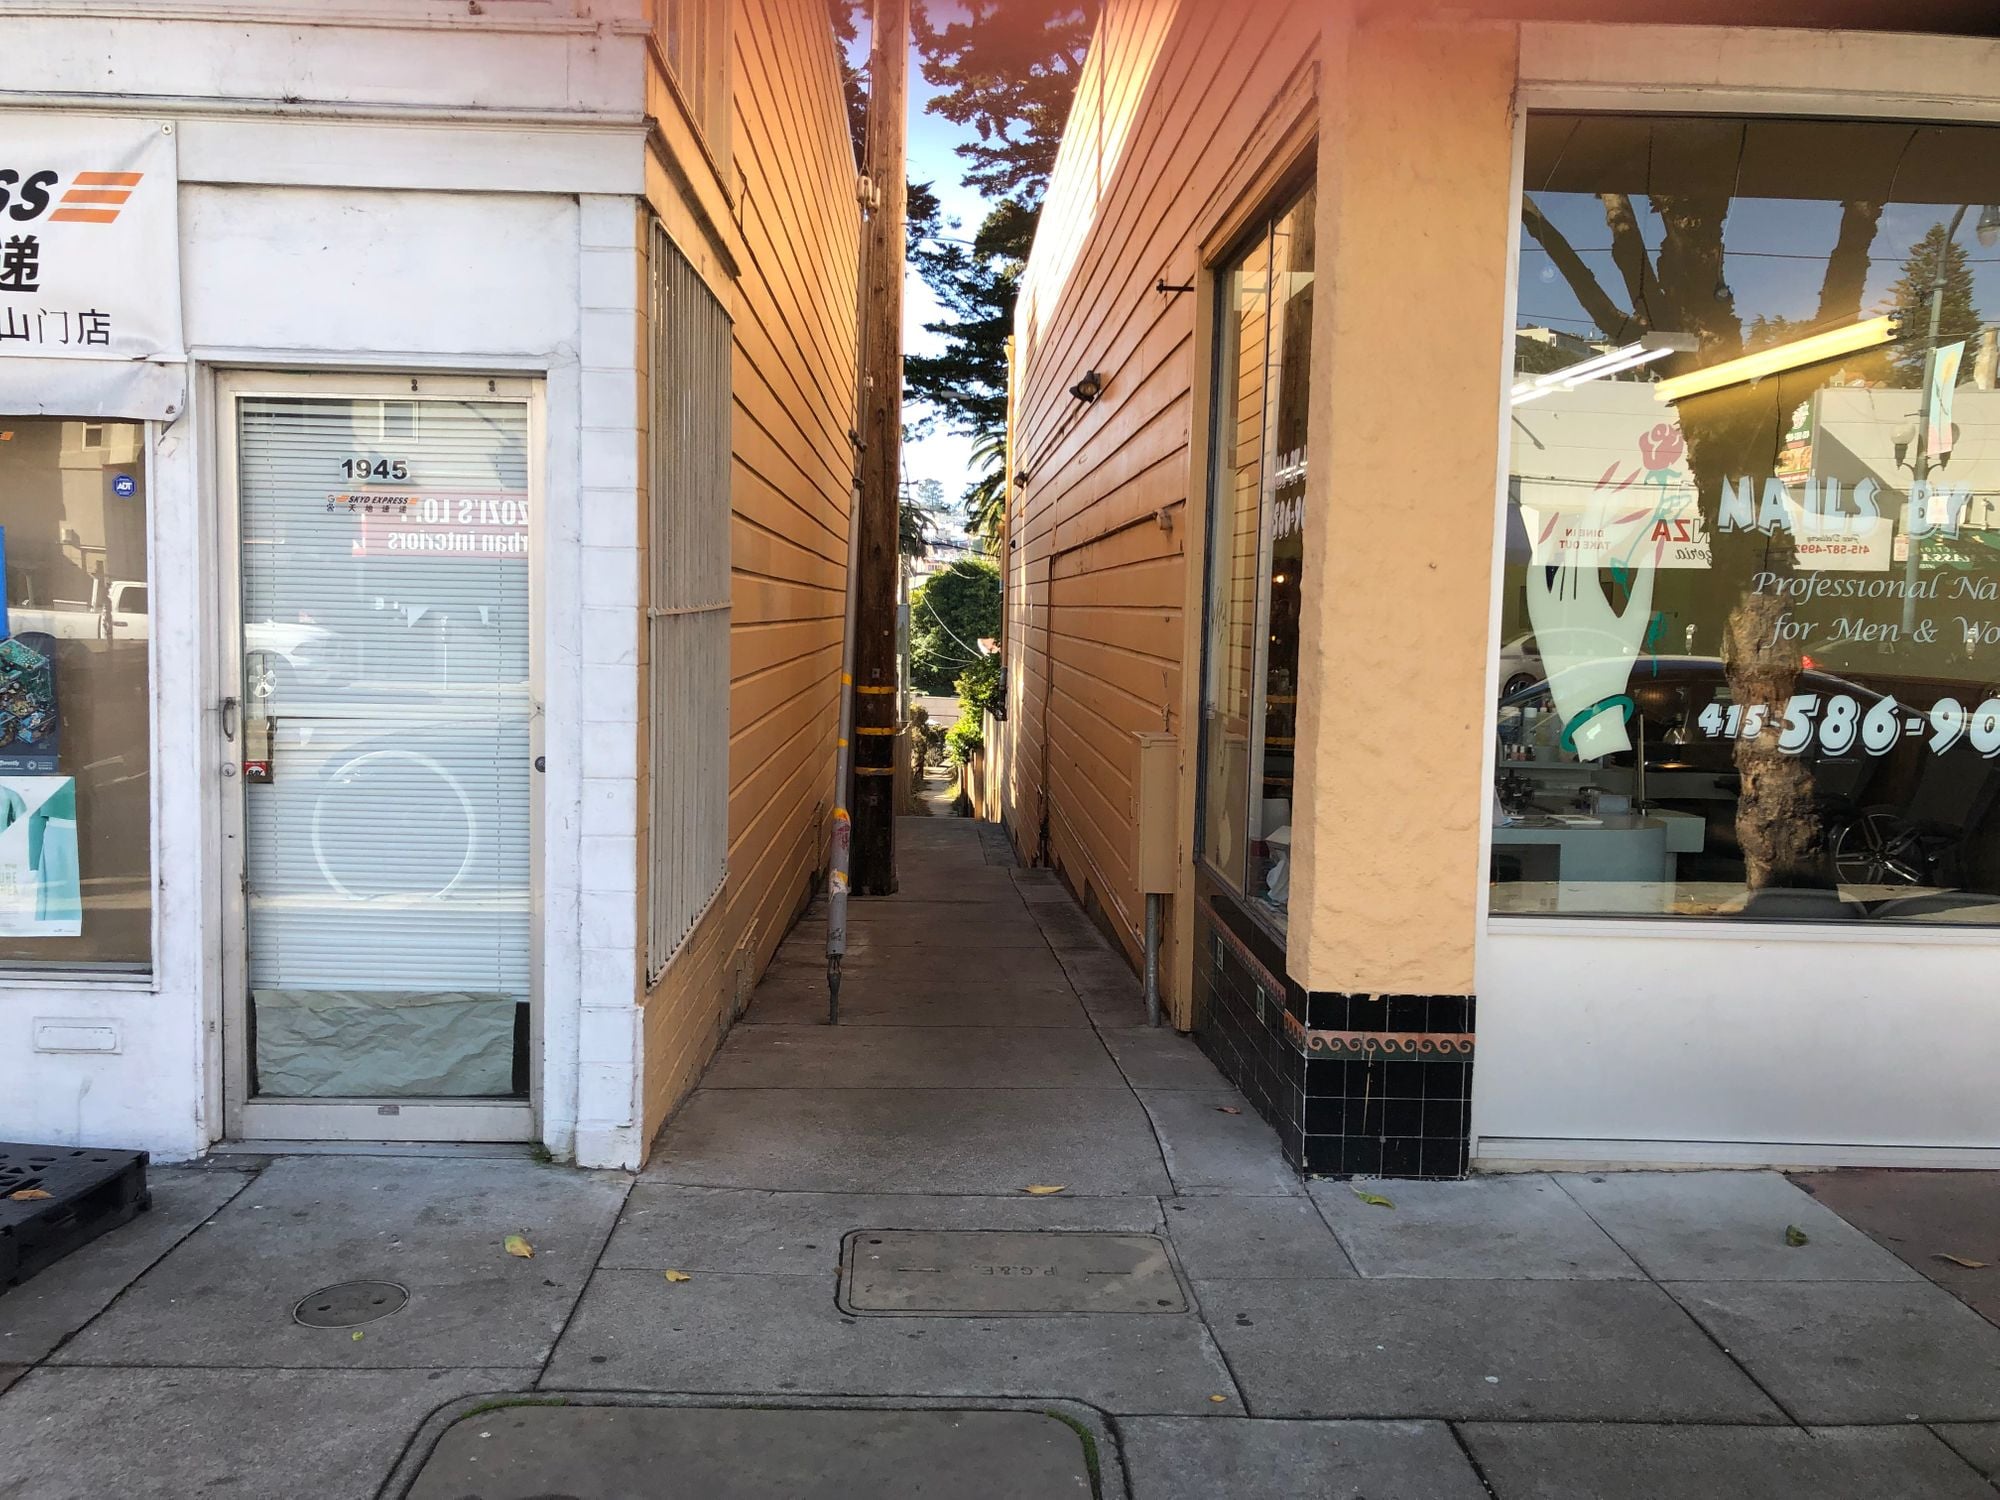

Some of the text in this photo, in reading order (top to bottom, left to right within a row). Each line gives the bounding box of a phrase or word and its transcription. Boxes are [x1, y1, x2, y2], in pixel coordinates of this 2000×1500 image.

[341, 458, 408, 480] 1945
[117, 482, 132, 490] ADT
[348, 495, 408, 504] SKYD EXPRESS
[1718, 475, 1973, 540] NAILS BY
[1752, 570, 1999, 606] Professional Na
[1760, 613, 2000, 648] for Men & Wo
